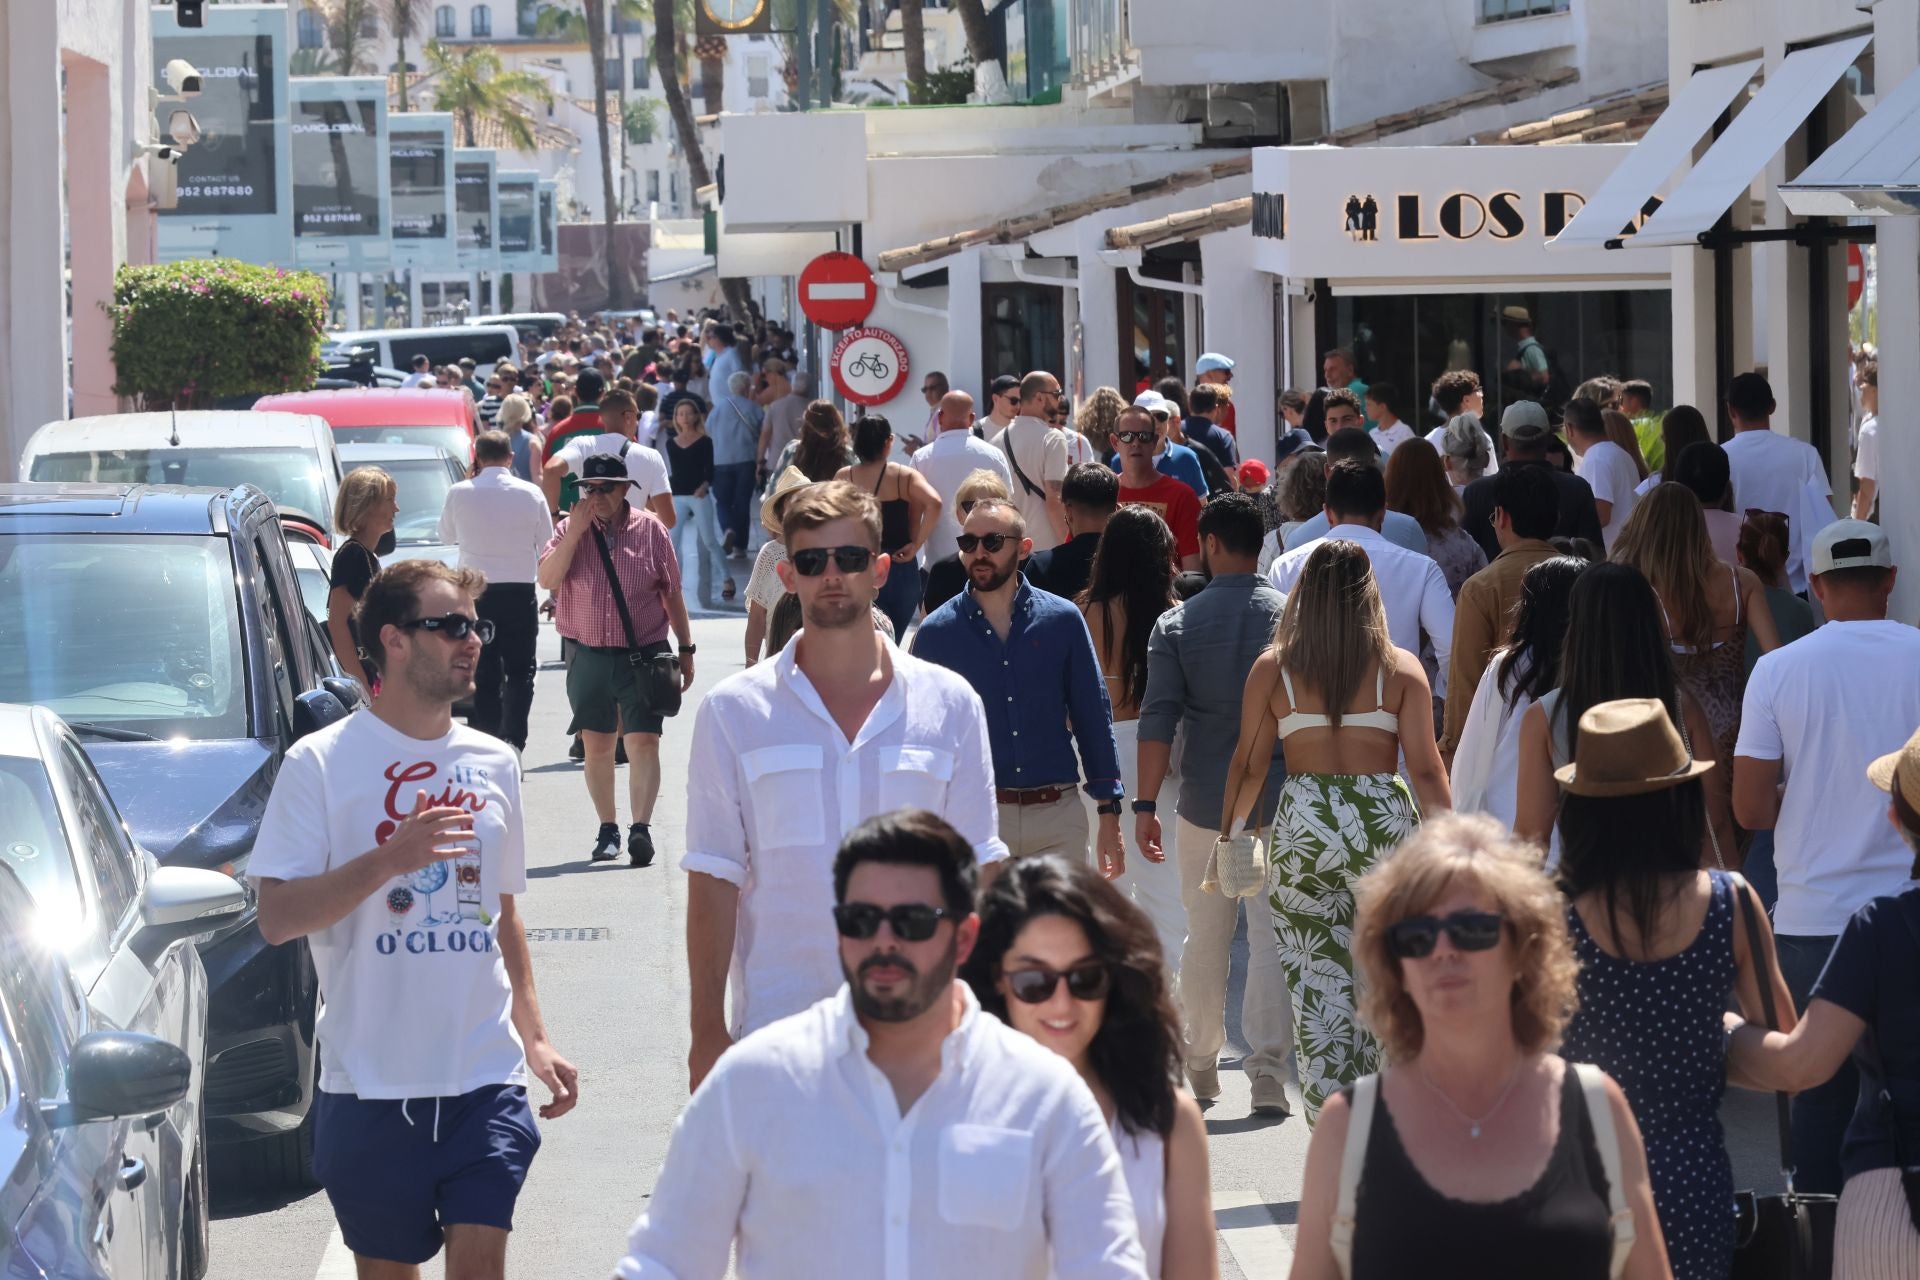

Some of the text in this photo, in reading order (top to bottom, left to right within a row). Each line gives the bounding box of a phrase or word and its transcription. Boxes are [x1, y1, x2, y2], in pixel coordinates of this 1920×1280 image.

[160, 67, 258, 78] DGLOBAL
[188, 175, 241, 183] CONTACT US
[176, 185, 254, 197] 952 687680
[1398, 192, 1524, 239] LOS
[831, 328, 909, 373] EXCEPTO AUTORIZADO
[455, 765, 489, 786] IT'S
